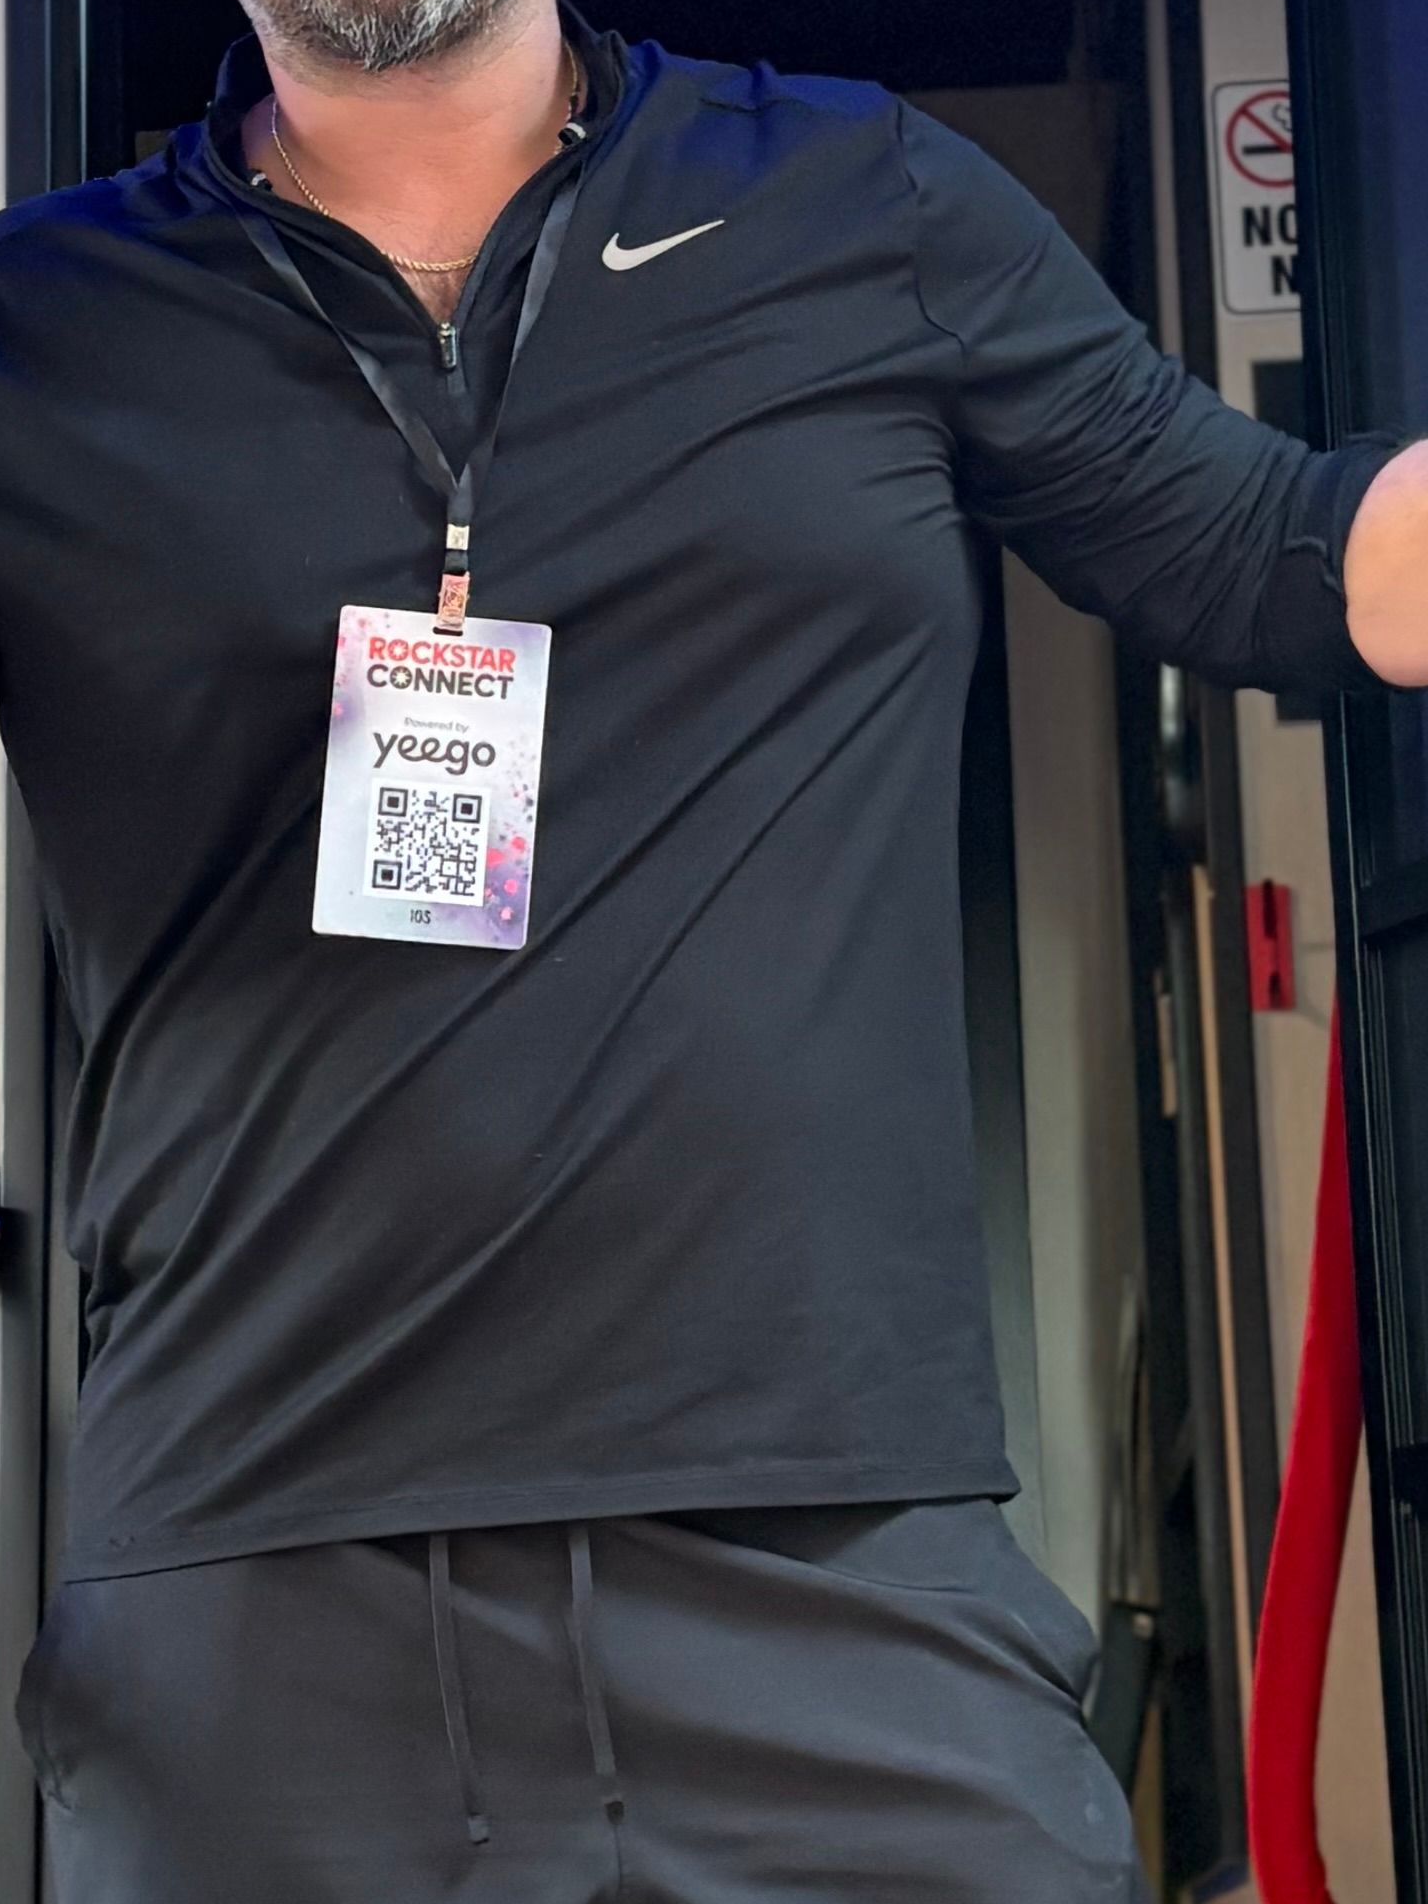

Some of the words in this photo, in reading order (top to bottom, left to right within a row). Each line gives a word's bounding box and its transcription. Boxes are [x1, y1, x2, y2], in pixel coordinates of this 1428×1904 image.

[369, 637, 516, 673] ROCKSTAR
[367, 664, 514, 699] CONNECT
[373, 733, 496, 776] yeego
